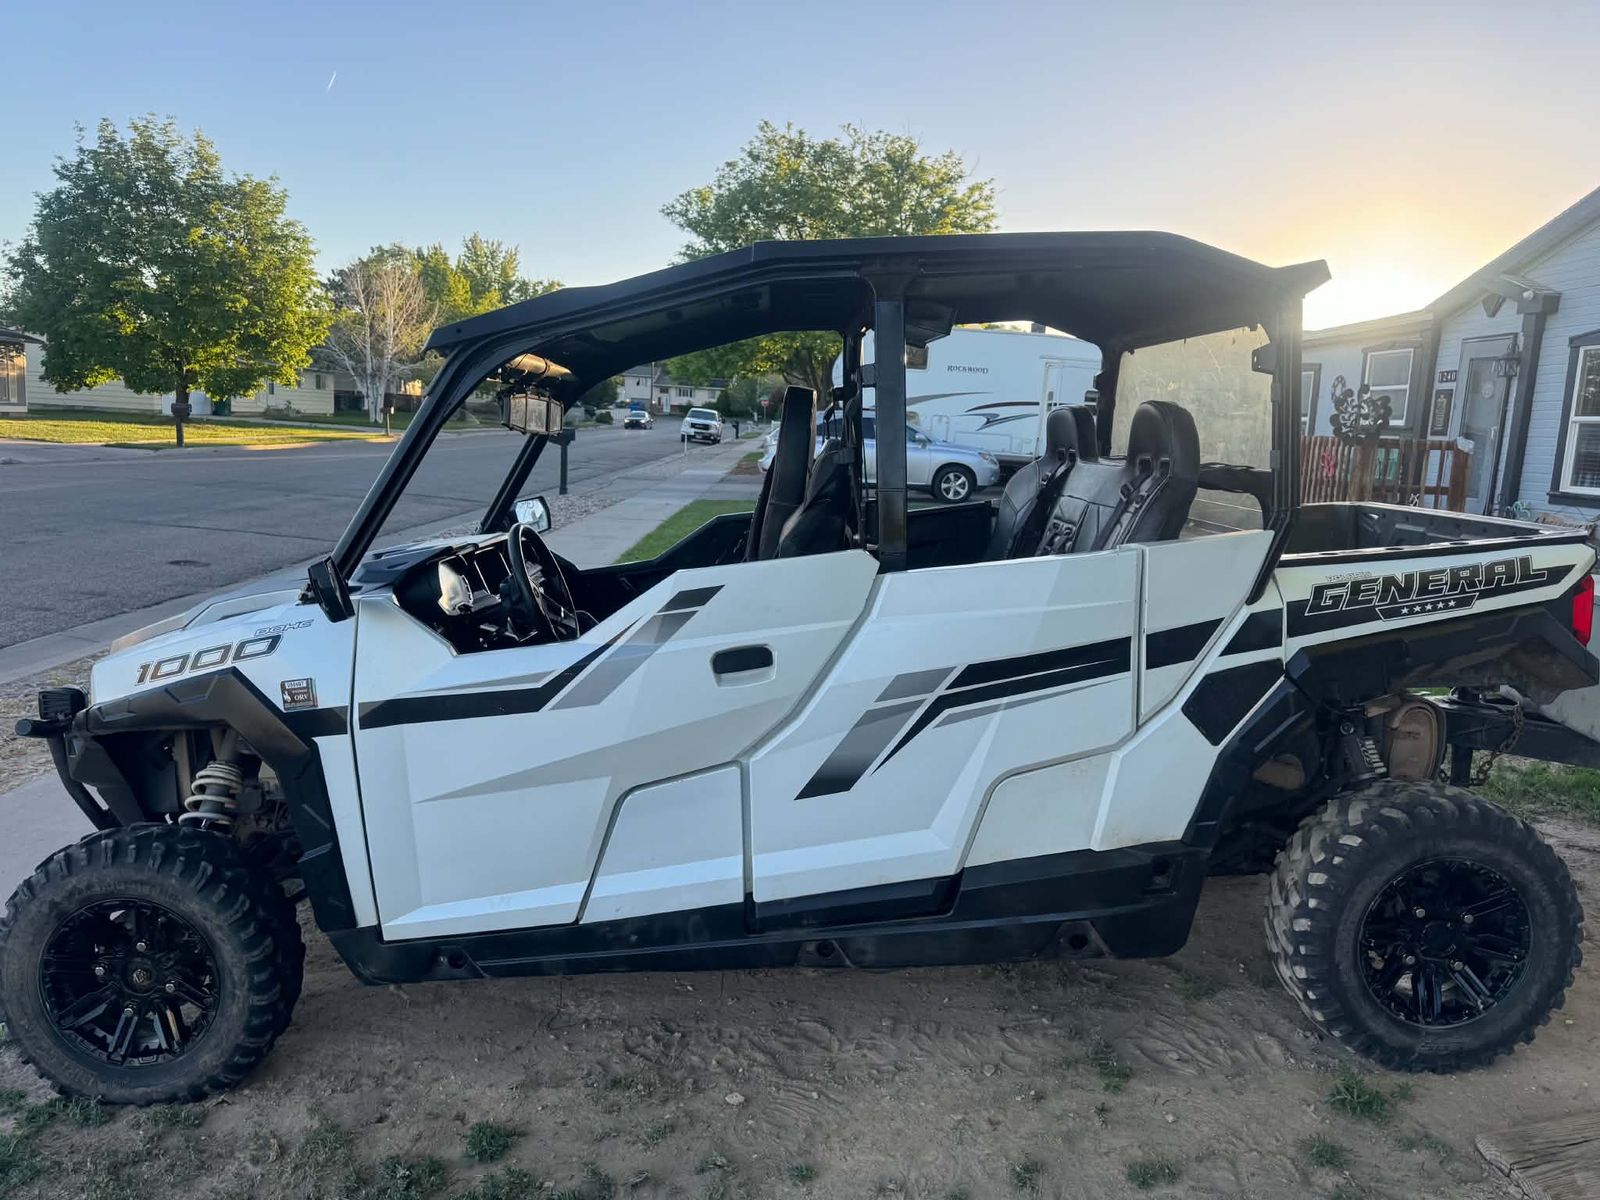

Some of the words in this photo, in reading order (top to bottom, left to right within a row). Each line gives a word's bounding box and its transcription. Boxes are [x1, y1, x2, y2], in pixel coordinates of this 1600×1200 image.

[946, 364, 989, 375] ROCKWOOD
[1305, 555, 1548, 616] GENERAL
[134, 633, 283, 686] 1000
